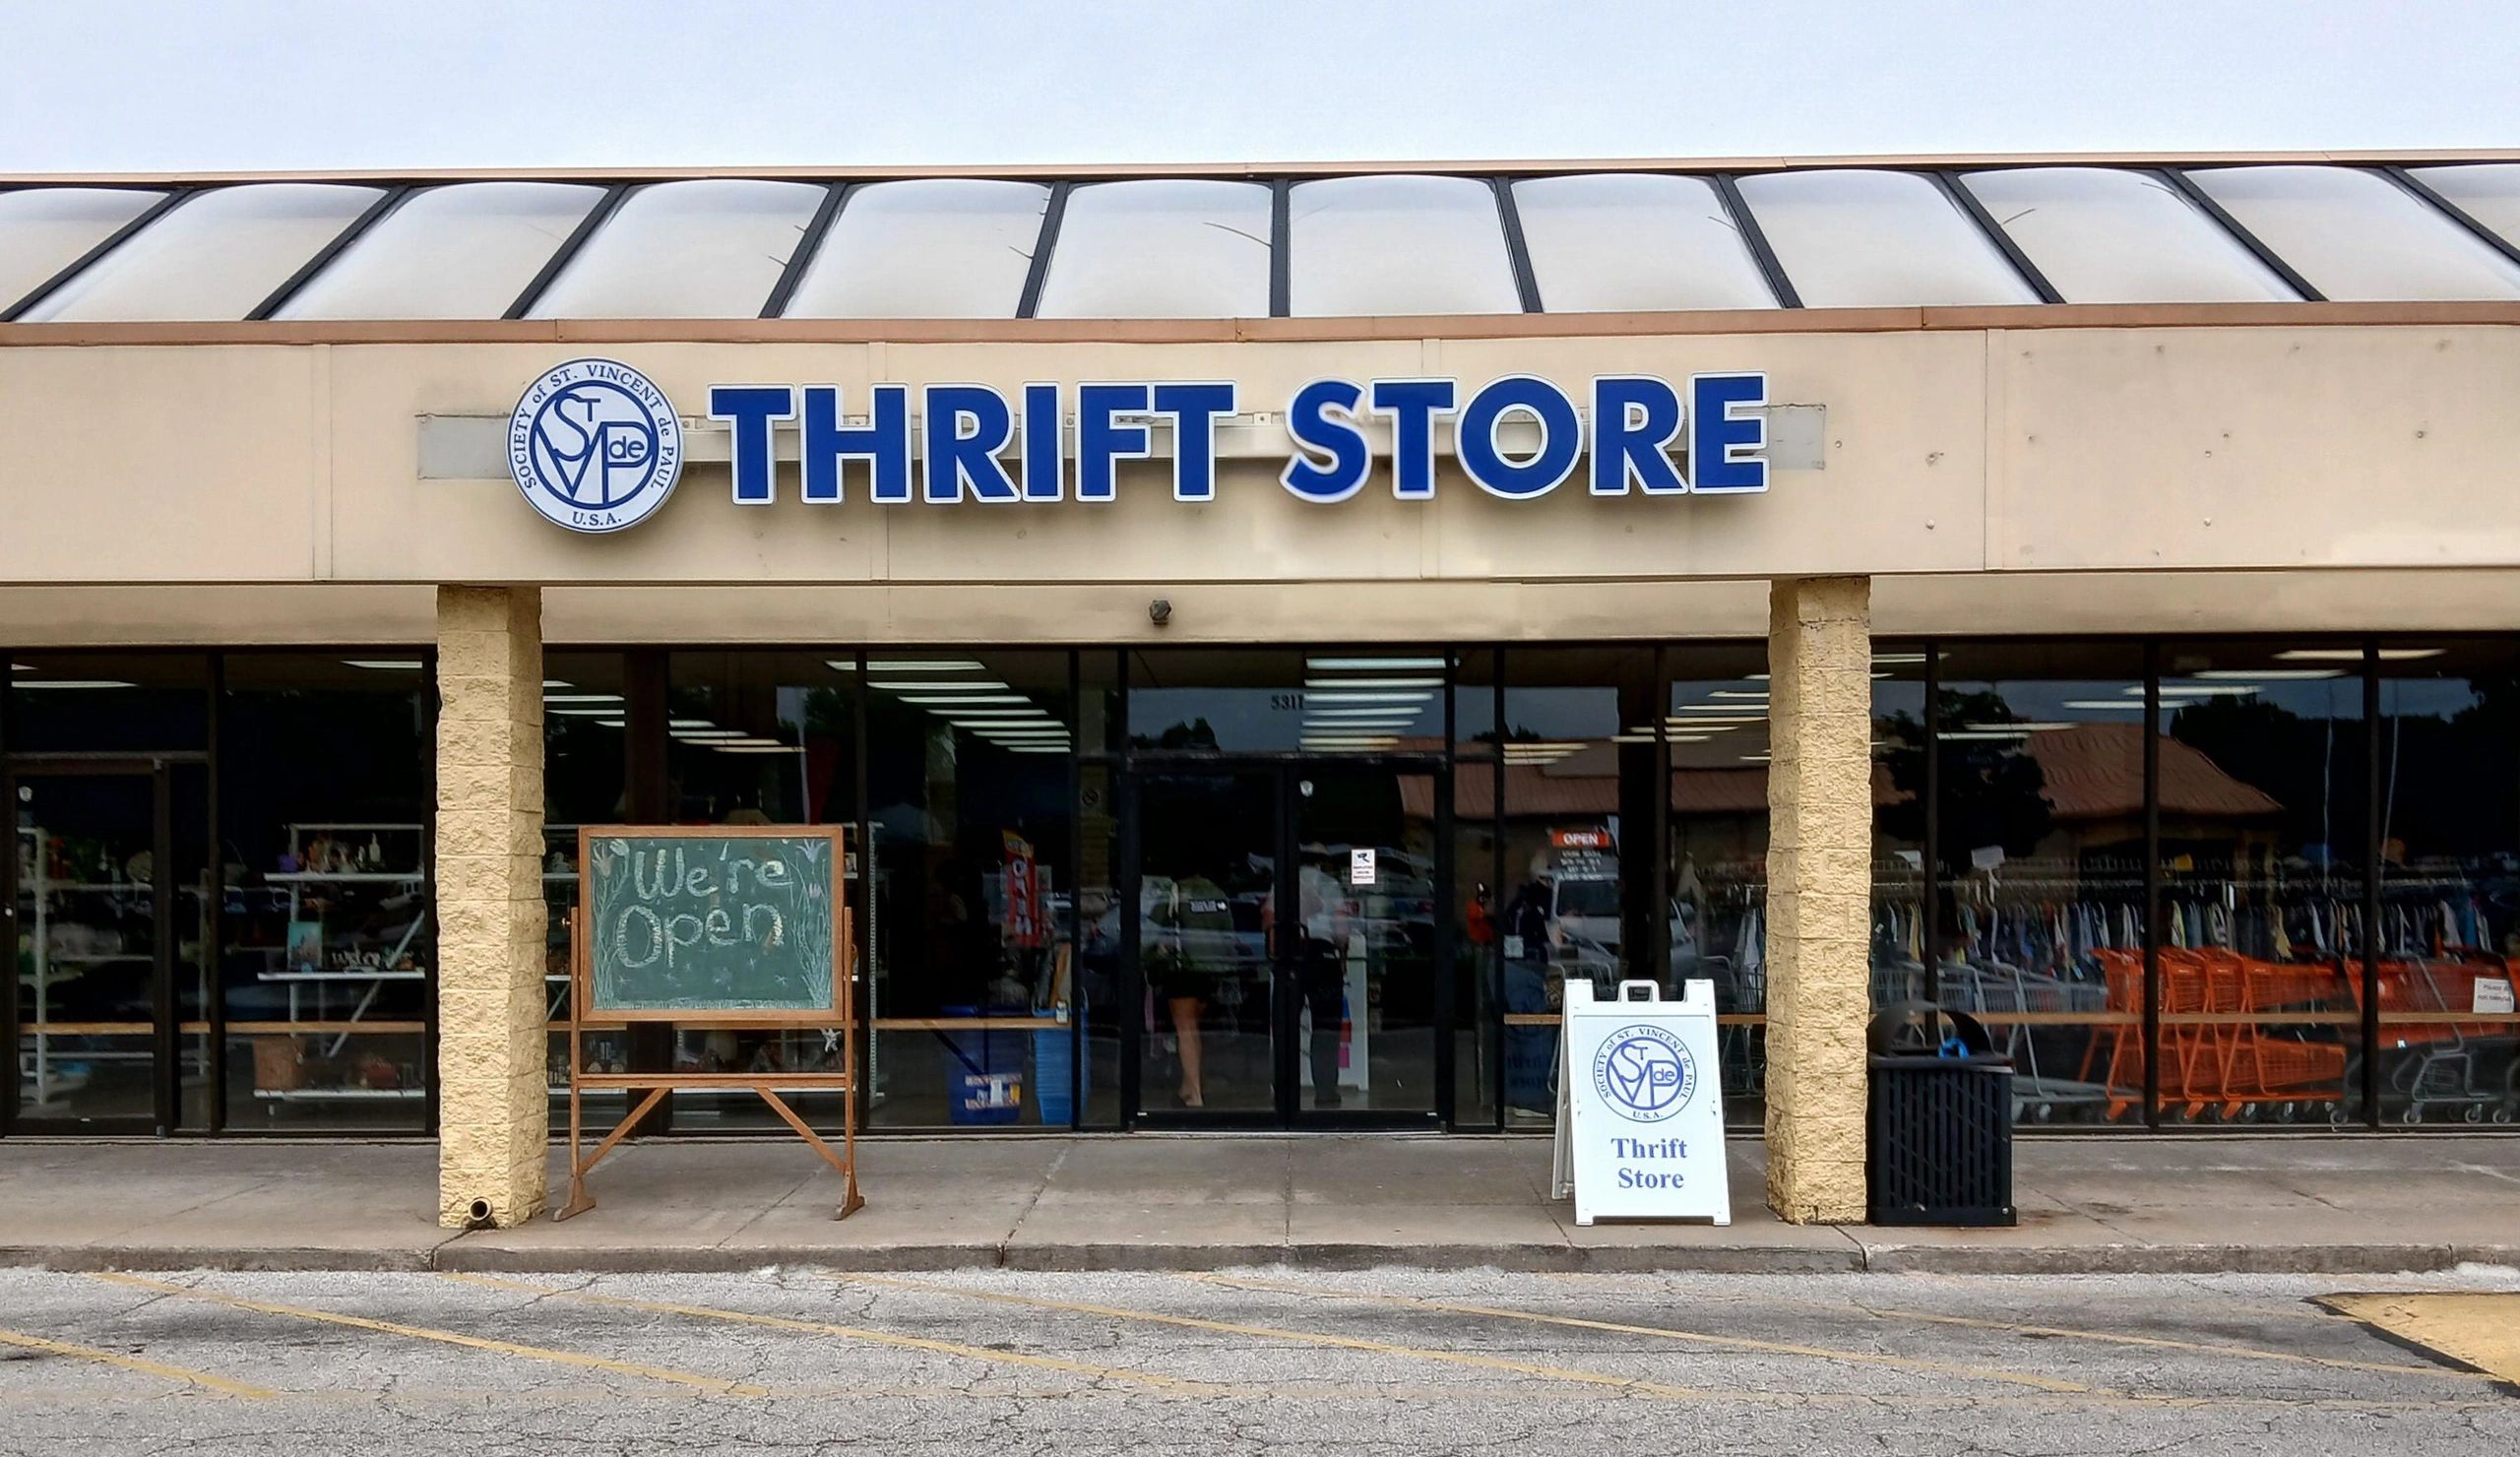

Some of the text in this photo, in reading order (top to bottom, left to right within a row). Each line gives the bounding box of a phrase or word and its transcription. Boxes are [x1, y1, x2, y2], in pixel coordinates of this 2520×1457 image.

[514, 364, 674, 489] SOCIETY of ST. VINCENT de PAUL
[709, 373, 1769, 503] THRIFT STORE
[608, 435, 645, 460] de
[572, 511, 622, 526] U.S.A.
[1562, 833, 1599, 846] OPEN
[635, 841, 793, 900] We're
[616, 903, 785, 968] Open
[1607, 1040, 1616, 1050] of
[1639, 1028, 1685, 1053] VINCENT
[1597, 1052, 1611, 1099] SOCIETY
[1682, 1057, 1691, 1069] de
[1679, 1074, 1693, 1099] PAUL
[1632, 1110, 1663, 1120] U.S.A.
[1610, 1138, 1688, 1159] Thrift
[1617, 1168, 1684, 1189] Store
